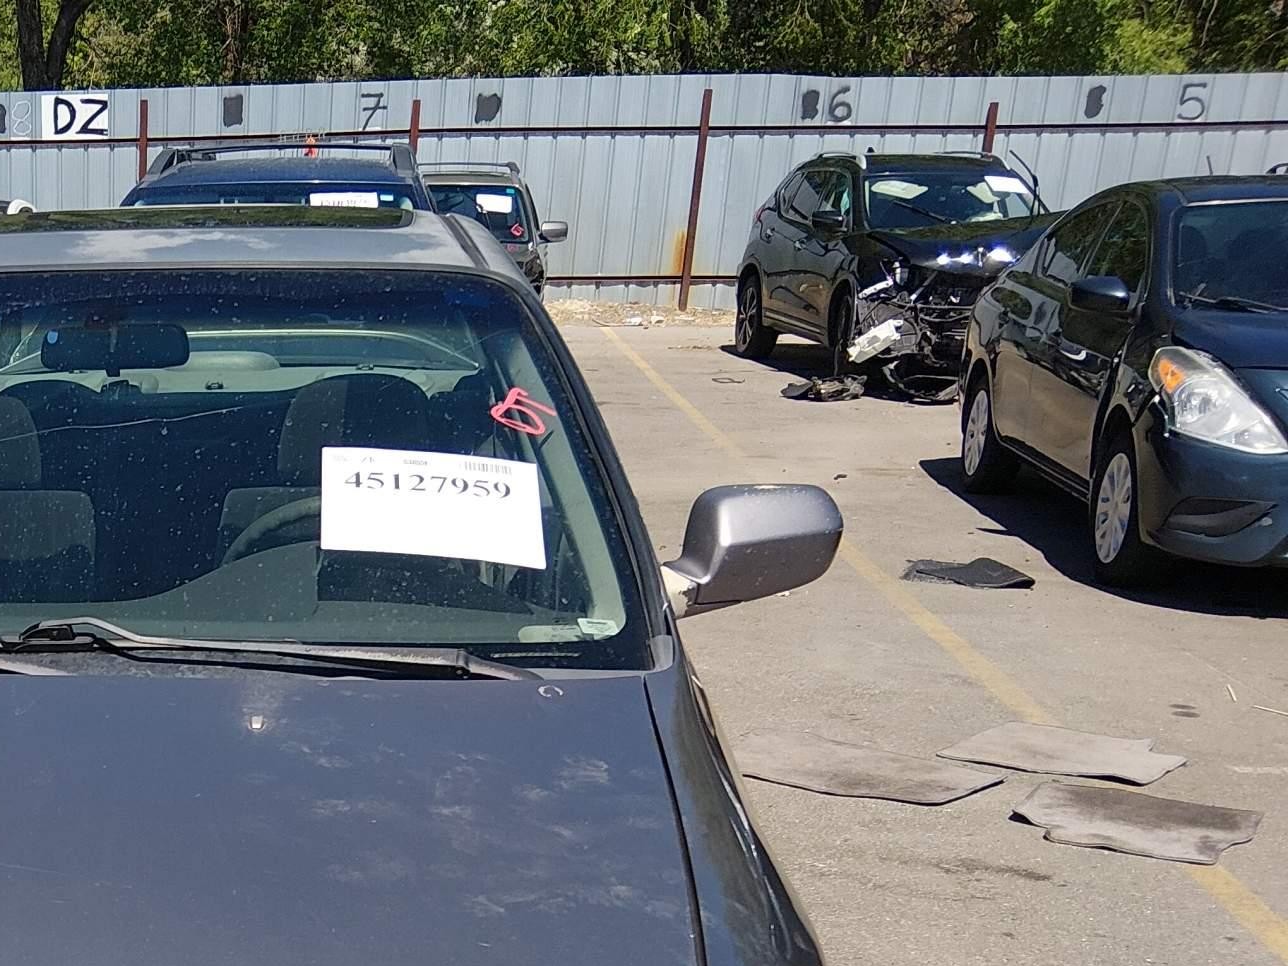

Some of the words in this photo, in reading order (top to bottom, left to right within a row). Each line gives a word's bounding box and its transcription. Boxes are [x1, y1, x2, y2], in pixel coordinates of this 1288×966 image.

[53, 96, 108, 136] DZ
[361, 92, 388, 130] 7
[829, 85, 852, 122] 6
[1177, 82, 1207, 120] 5
[344, 471, 512, 499] 45127959
